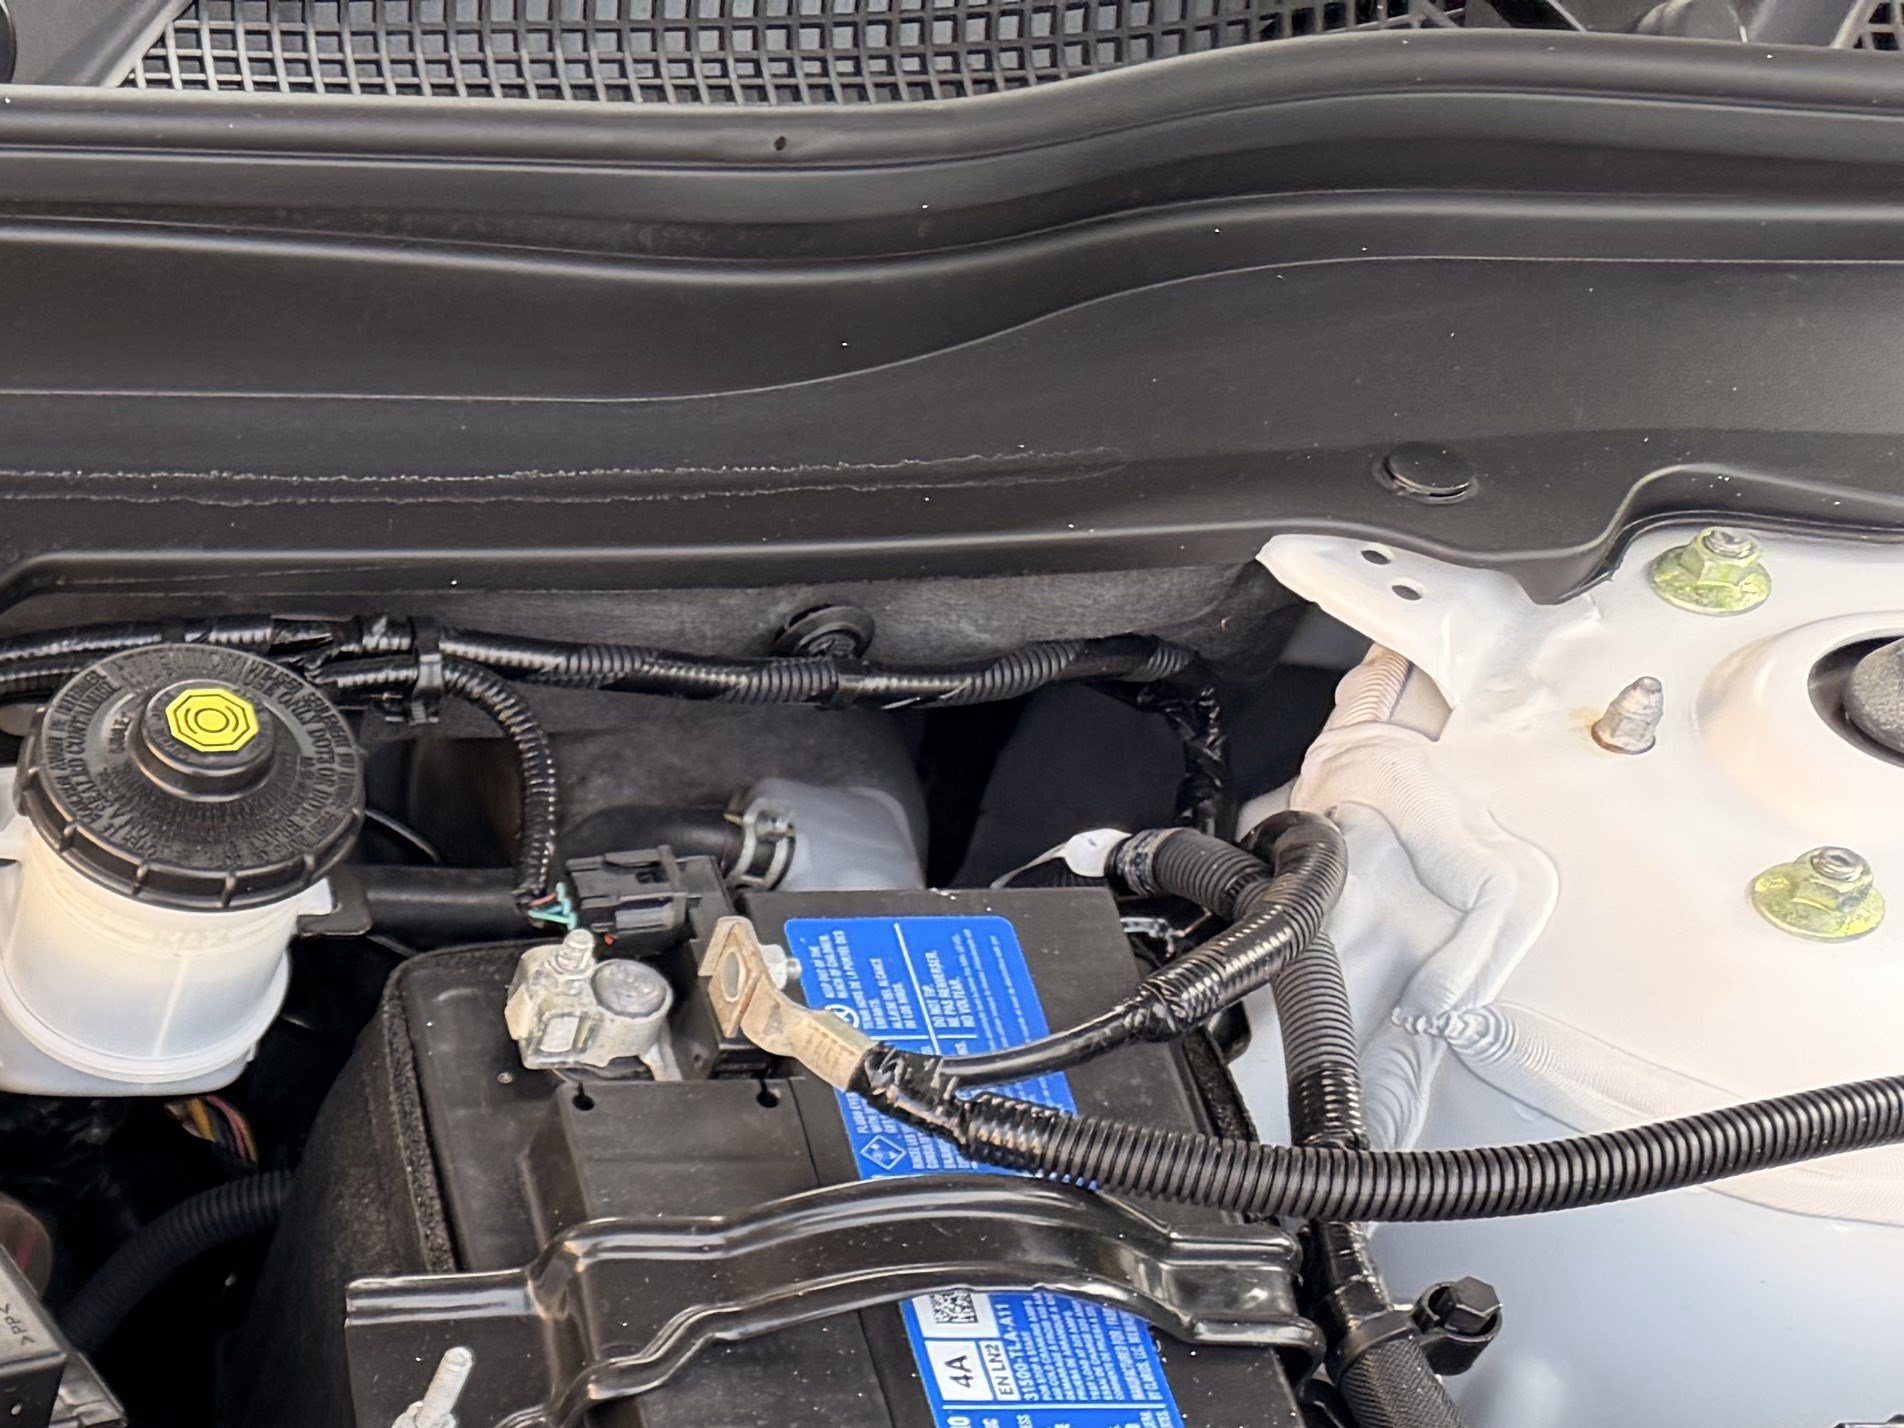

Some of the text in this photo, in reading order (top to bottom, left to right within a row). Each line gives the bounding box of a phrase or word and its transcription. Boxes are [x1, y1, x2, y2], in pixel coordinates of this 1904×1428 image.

[941, 1354, 978, 1388] 4A
[983, 1343, 1015, 1395] EN LN2
[993, 1303, 1039, 1400] 31500-TLA-A11
